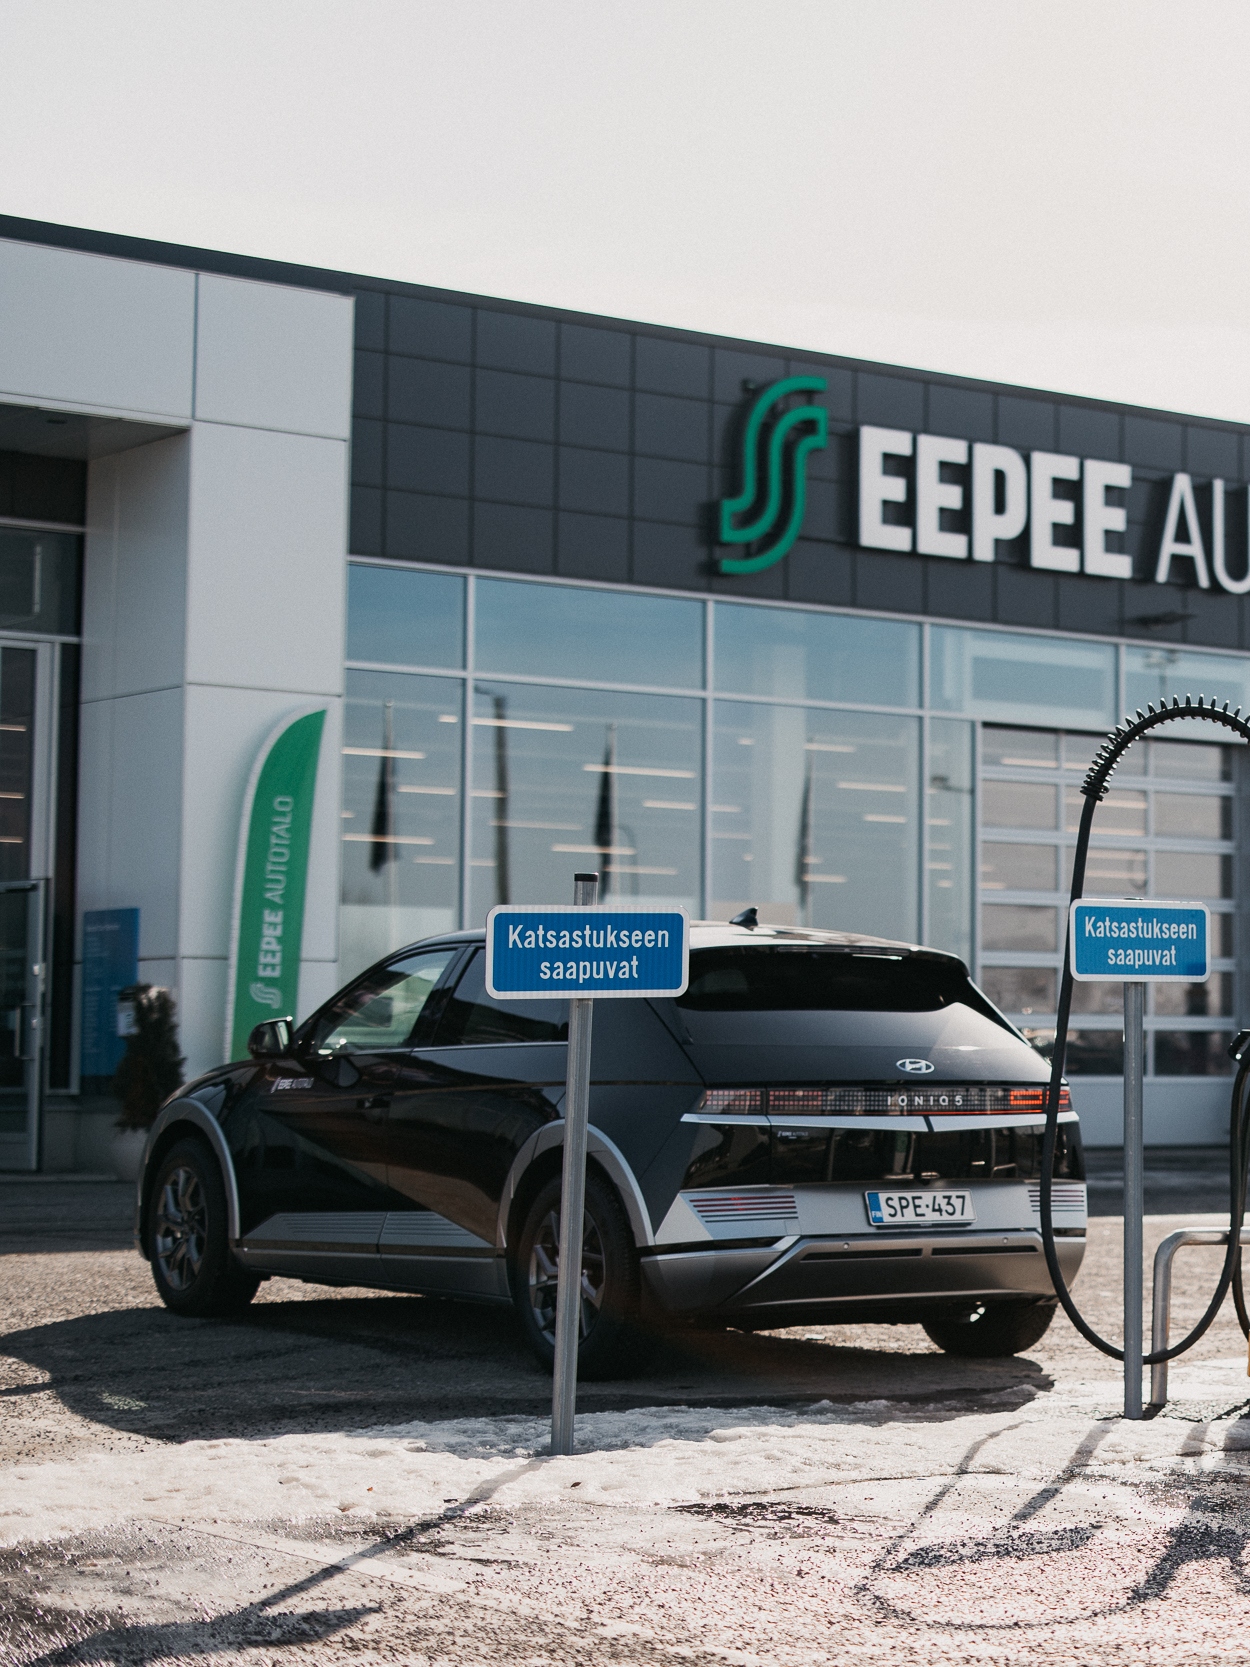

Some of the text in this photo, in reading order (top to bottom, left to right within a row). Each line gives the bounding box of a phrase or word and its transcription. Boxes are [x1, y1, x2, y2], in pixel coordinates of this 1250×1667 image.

[859, 424, 1133, 580] EEPEE
[256, 794, 295, 978] EEPEE AUTOTALO
[508, 924, 670, 949] Katsastukseen
[1084, 915, 1197, 940] Katsastukseen
[539, 955, 639, 984] saapuvat
[1107, 944, 1177, 970] saapuvat
